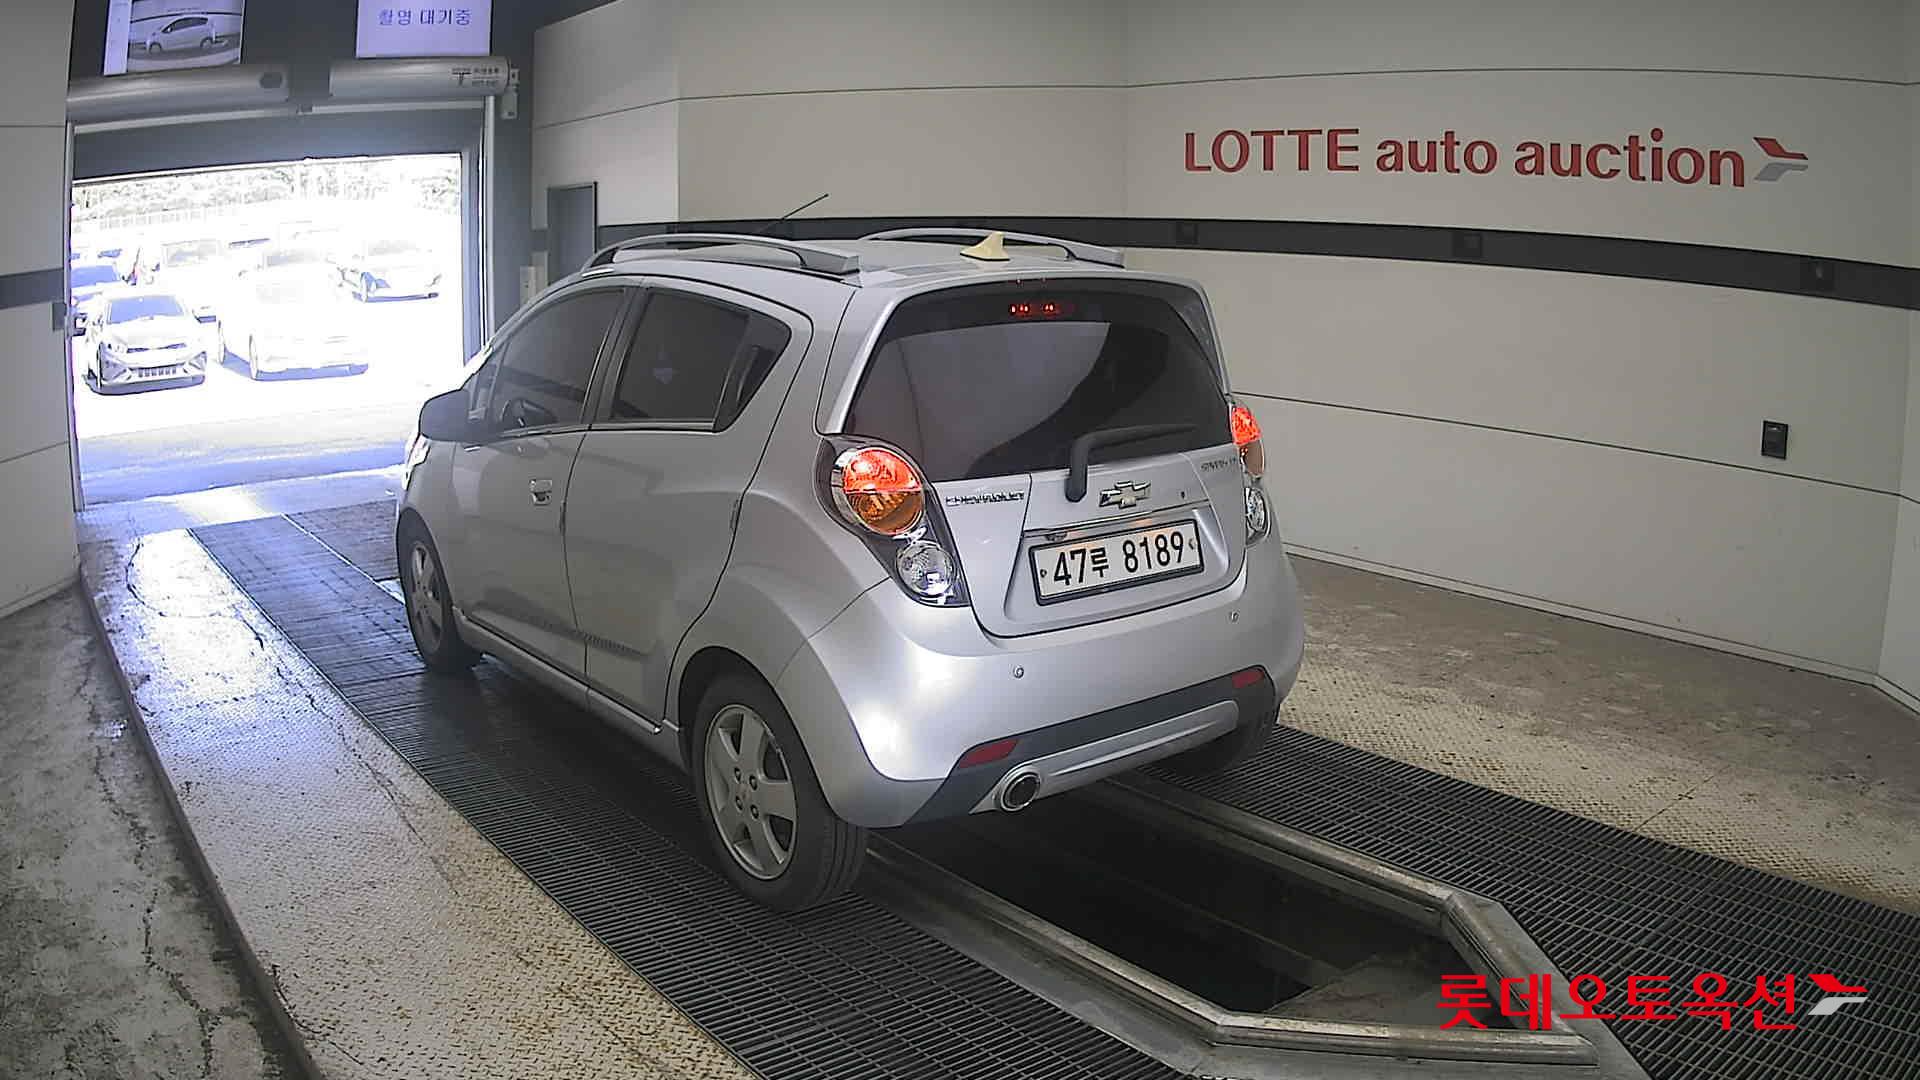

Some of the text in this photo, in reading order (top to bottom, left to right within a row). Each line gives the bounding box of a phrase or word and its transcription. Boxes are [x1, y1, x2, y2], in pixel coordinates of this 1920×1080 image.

[420, 8, 471, 26] 대기중
[1183, 128, 1744, 188] LOTTE auto auction
[1053, 531, 1184, 586] 47루 8189
